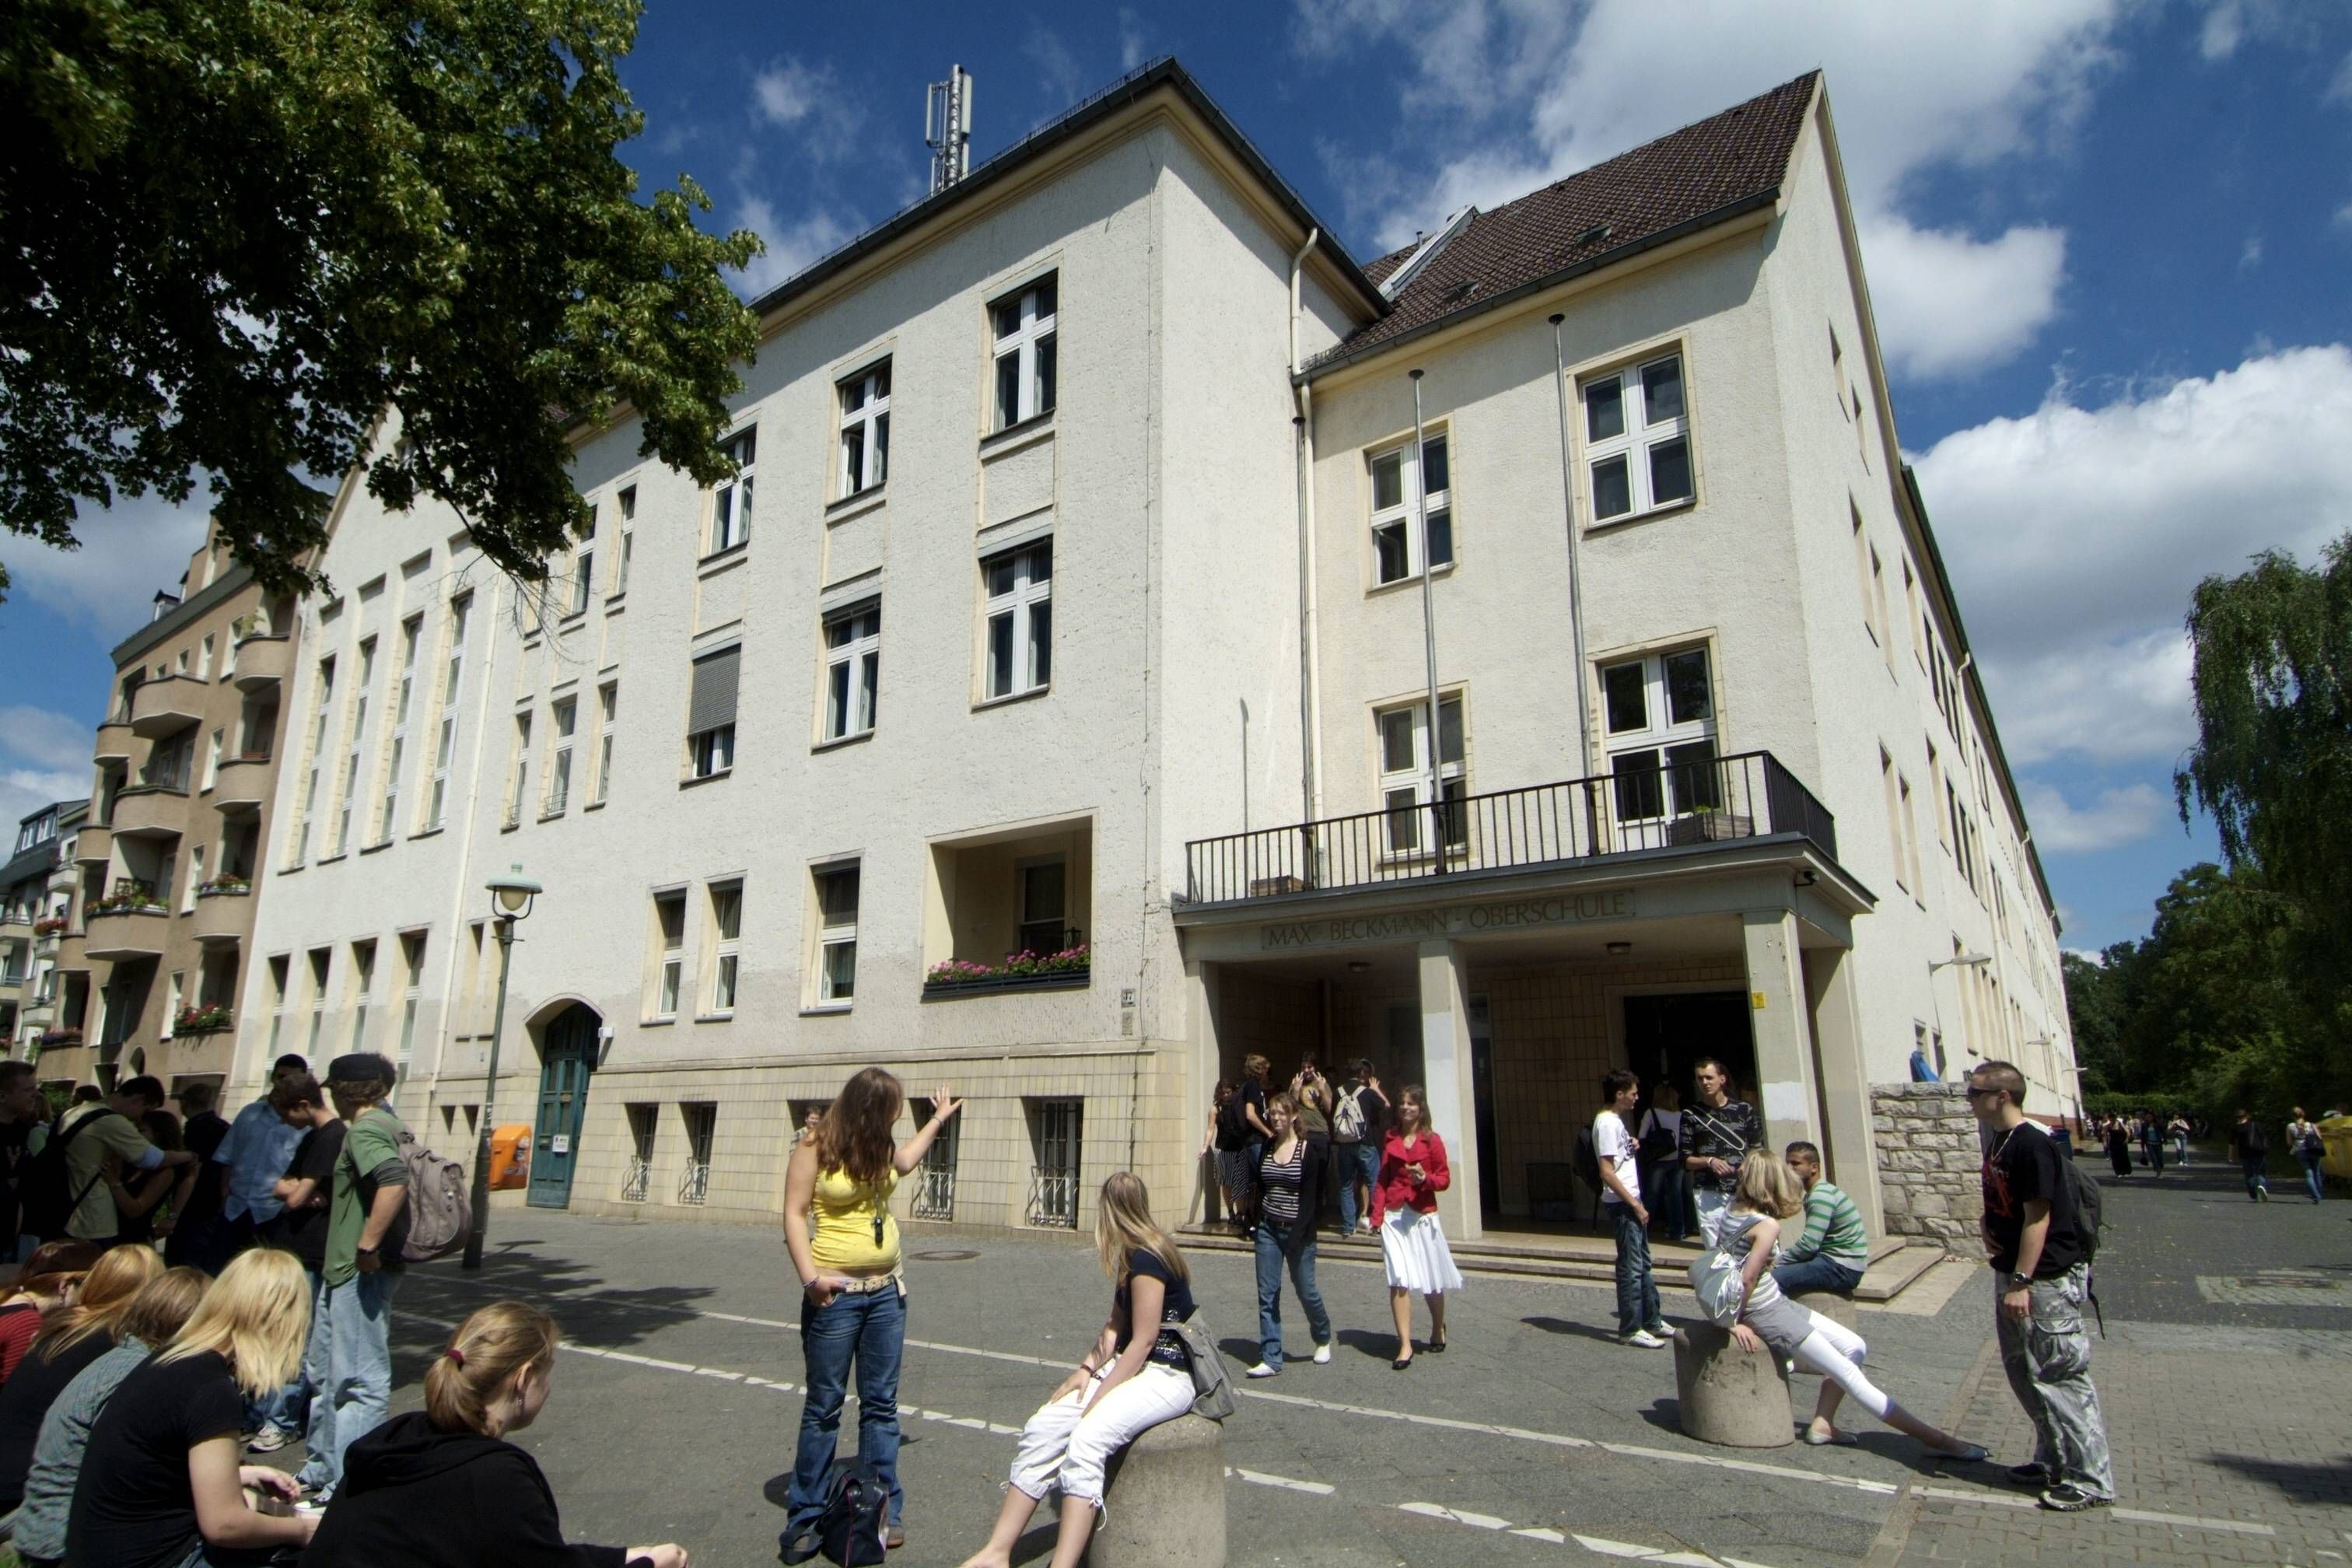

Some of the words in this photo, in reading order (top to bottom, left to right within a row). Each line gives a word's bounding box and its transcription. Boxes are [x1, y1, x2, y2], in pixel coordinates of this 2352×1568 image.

[1269, 922, 1311, 947] MAX
[1330, 908, 1449, 942] BECKMANN
[1468, 894, 1627, 929] OBERSCHULE
